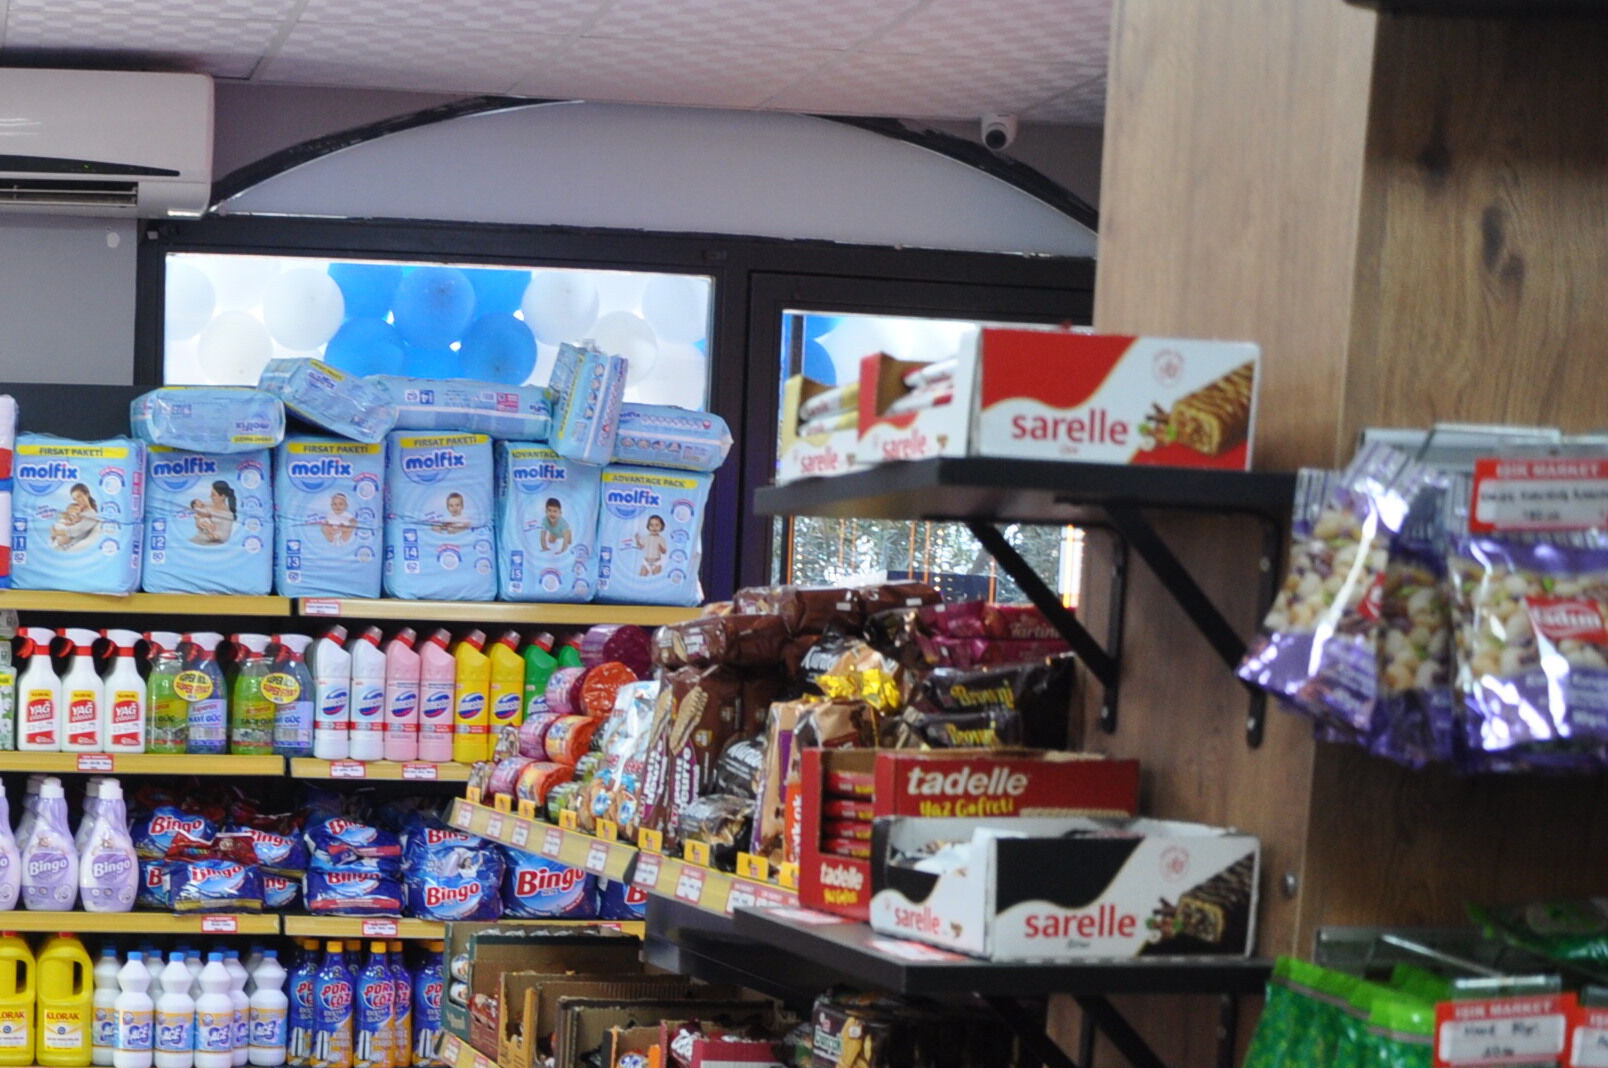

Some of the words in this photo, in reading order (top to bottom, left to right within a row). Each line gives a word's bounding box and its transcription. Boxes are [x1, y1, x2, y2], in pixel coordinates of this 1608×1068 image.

[1011, 409, 1129, 446] sarelle
[881, 431, 927, 459] sarelle
[153, 458, 216, 474] molfix
[292, 459, 352, 475] molfix
[406, 452, 465, 469] molfix
[19, 462, 78, 479] molfix
[514, 465, 565, 479] molfix
[608, 490, 660, 506] molfix
[30, 701, 49, 716] YAĞ
[73, 701, 92, 716] YAĞ
[116, 701, 136, 716] YAĞ
[907, 765, 1028, 796] tadelle
[150, 816, 204, 835] Bingo
[428, 829, 470, 845] Bing
[30, 859, 67, 877] Bingo
[94, 859, 131, 878] Bingo
[820, 862, 864, 891] tadelle
[427, 882, 481, 907] Bingo
[894, 905, 940, 935] sarelle
[1025, 903, 1137, 939] sarelle
[47, 1012, 80, 1020] KLORAK
